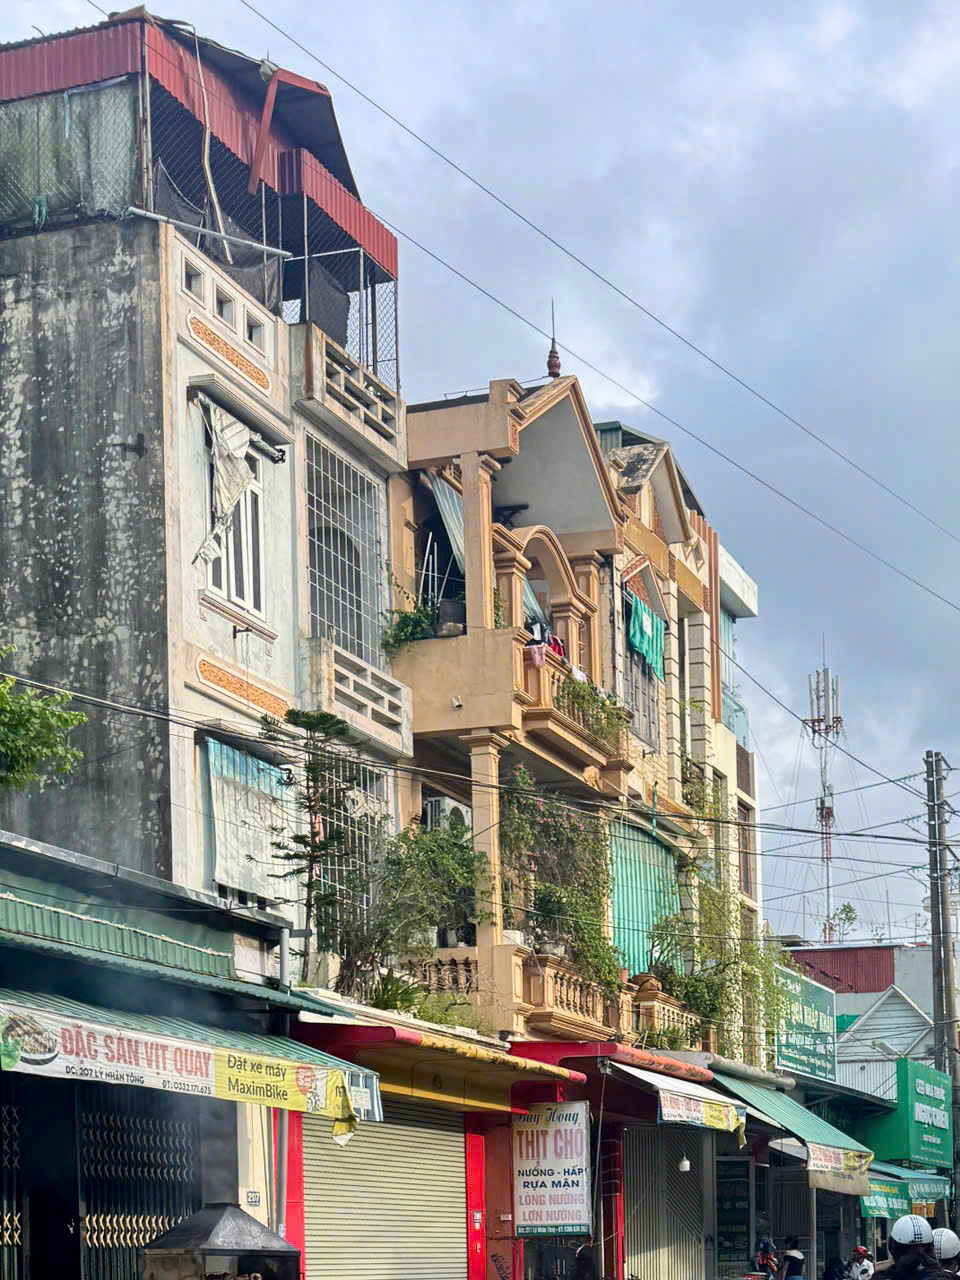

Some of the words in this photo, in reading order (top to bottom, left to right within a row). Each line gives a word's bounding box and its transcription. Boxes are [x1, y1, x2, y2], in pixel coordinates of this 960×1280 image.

[60, 1024, 98, 1065] ĐẶC
[104, 1028, 140, 1067] SẢN
[144, 1041, 168, 1075] VỊT
[174, 1047, 211, 1078] QUAY
[79, 1067, 94, 1077] 207
[95, 1067, 104, 1079] LÝ
[126, 1072, 145, 1085] TÔNG
[227, 1053, 248, 1073] Đặt
[250, 1060, 262, 1074] xe
[265, 1063, 287, 1081] máy
[228, 1077, 288, 1101] MaximBike
[517, 1129, 549, 1167] THỊT
[554, 1122, 585, 1160] CHÓ
[518, 1165, 555, 1177] NƯỚNG
[563, 1164, 584, 1176] HẤP
[523, 1180, 548, 1191] RỰA
[551, 1177, 580, 1191] MẬN
[519, 1191, 546, 1206] LÒNG
